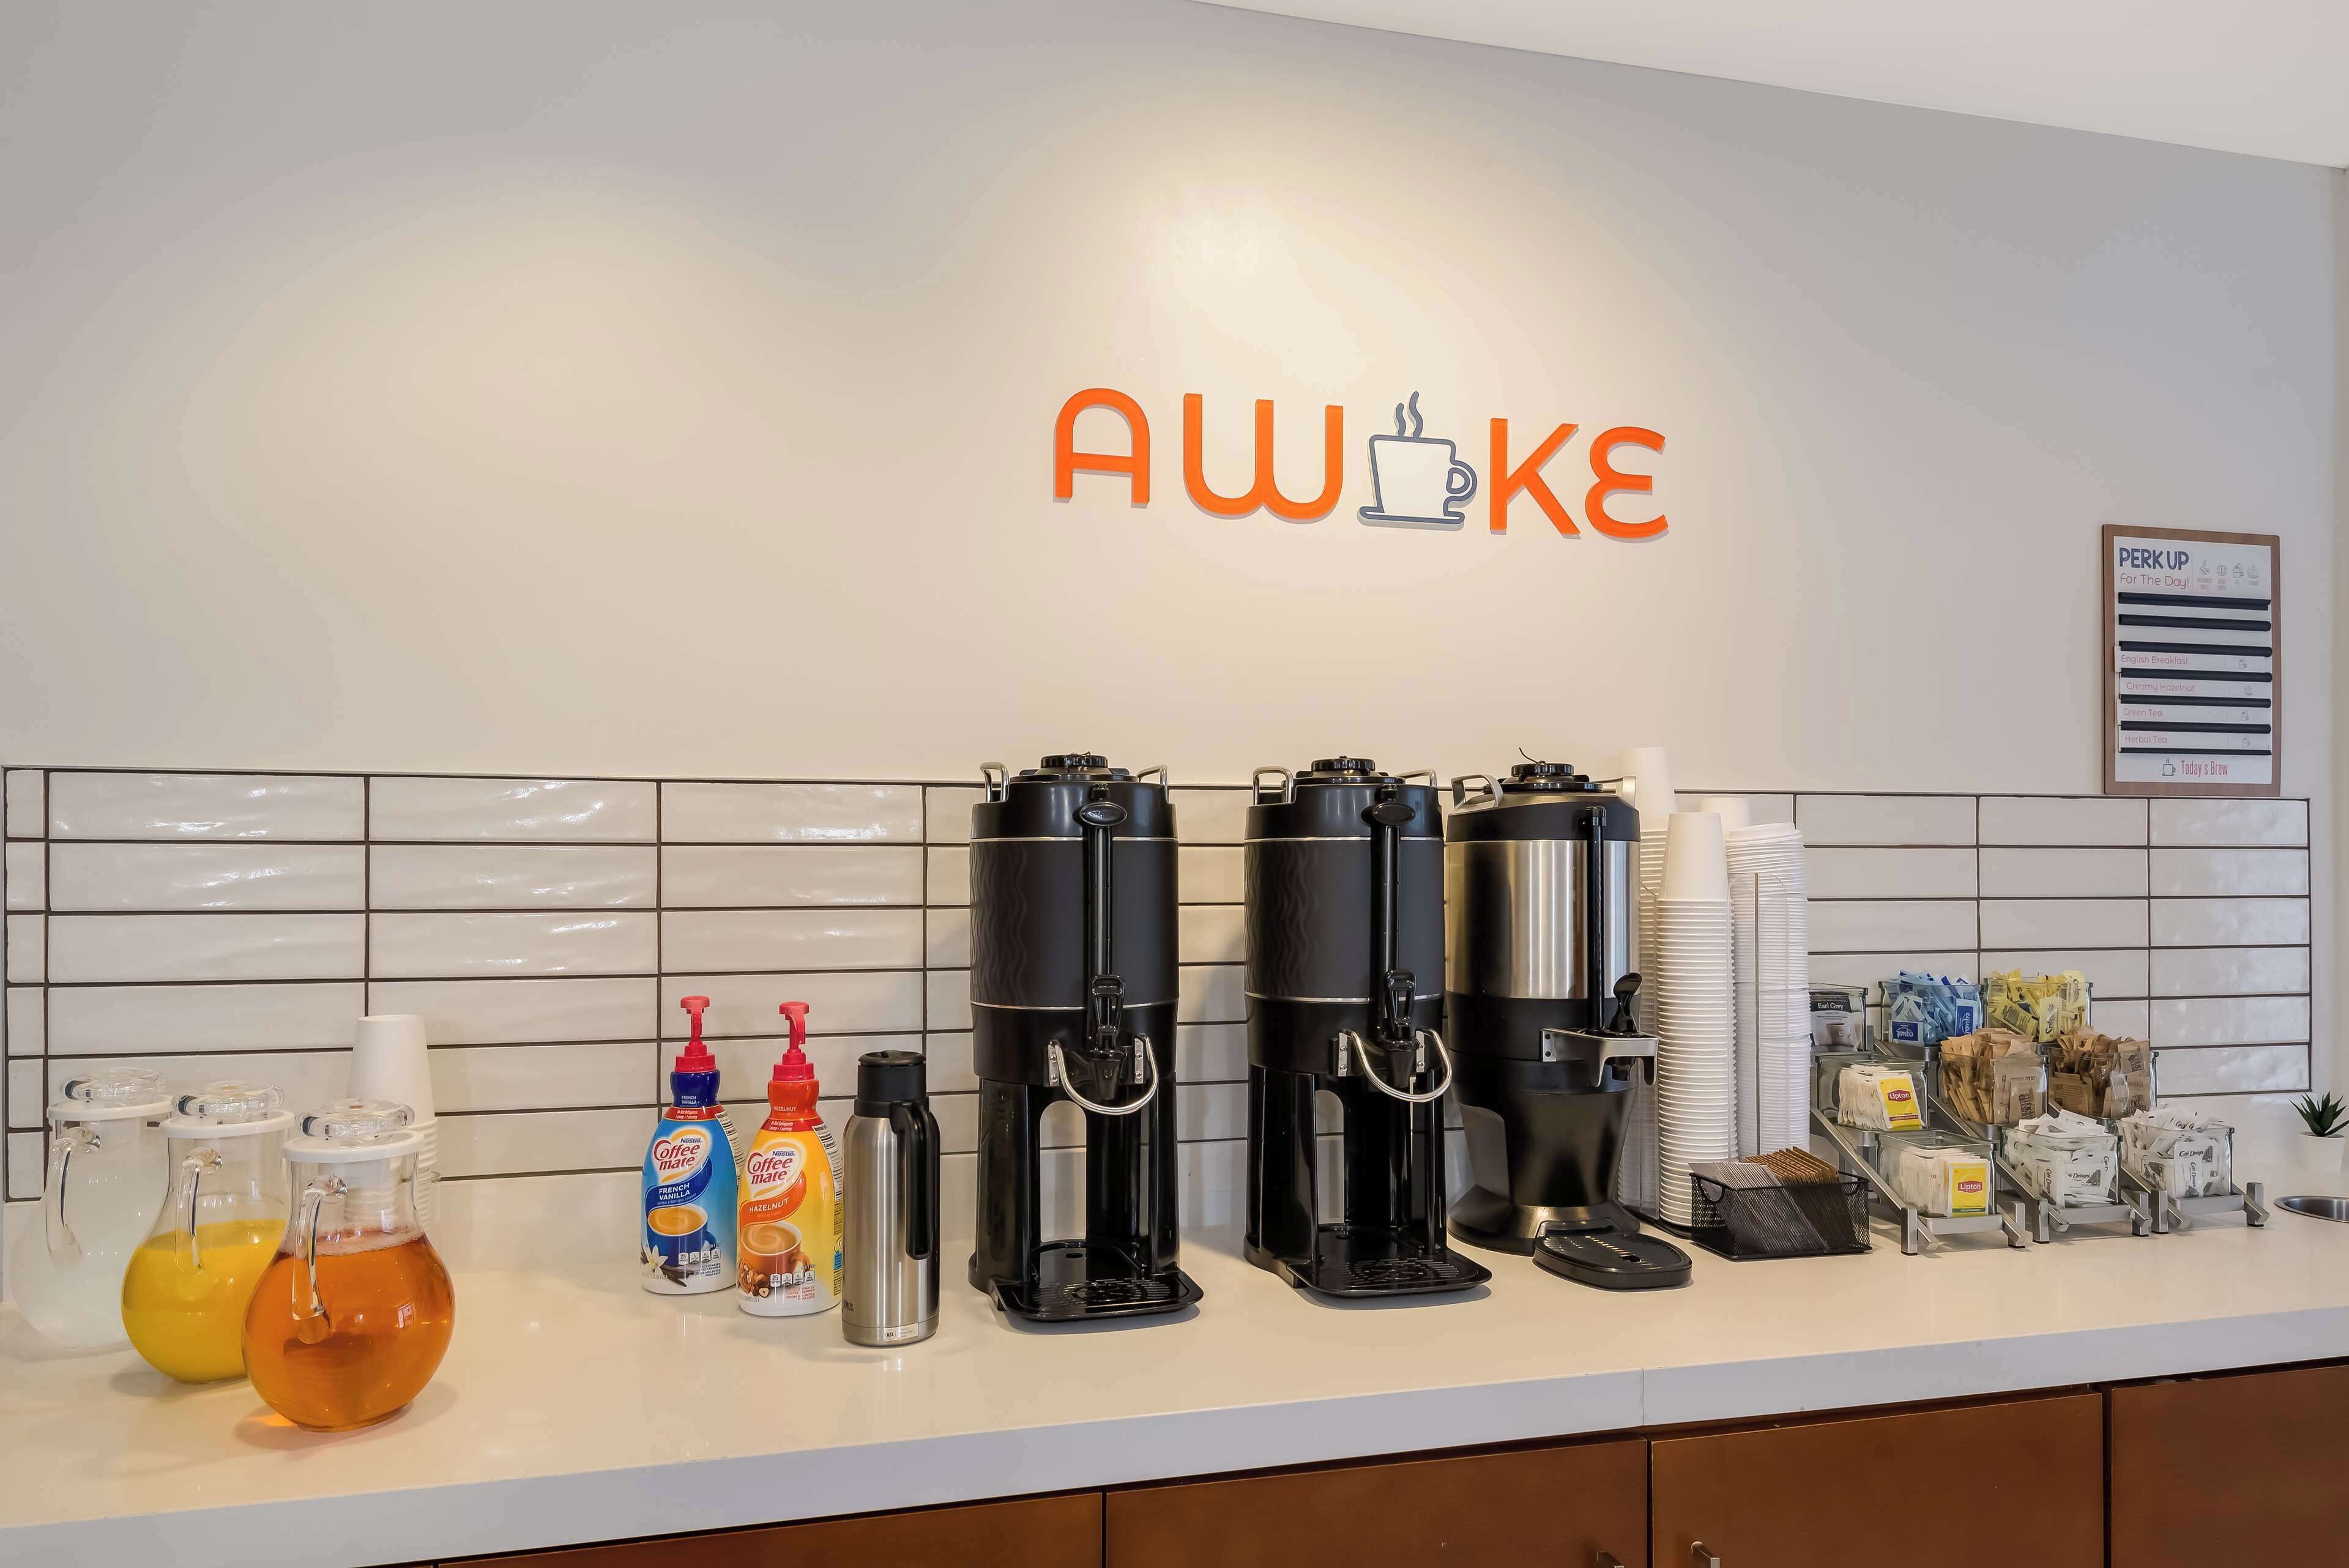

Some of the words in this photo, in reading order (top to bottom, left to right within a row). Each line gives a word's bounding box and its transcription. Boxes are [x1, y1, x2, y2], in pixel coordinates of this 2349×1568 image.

[2119, 547, 2164, 570] PERK
[2167, 551, 2189, 571] UP
[2120, 573, 2137, 584] For
[2140, 574, 2161, 585] The
[2165, 576, 2189, 590] Day!
[2121, 655, 2150, 664] English
[2151, 656, 2189, 665] Breakfast
[2126, 682, 2158, 692] Creamy
[2160, 683, 2195, 692] Hazelnut
[2123, 708, 2146, 716] Green
[2148, 708, 2162, 717] Tea
[2153, 735, 2167, 744] Tea
[2181, 760, 2208, 777] Today's
[2211, 761, 2228, 776] Brew
[1896, 1028, 1913, 1038] equal
[654, 1140, 700, 1161] Coffee
[658, 1156, 695, 1171] mate
[747, 1152, 793, 1175] Coffee
[751, 1170, 787, 1184] mate
[658, 1183, 690, 1194] FRENCH
[659, 1189, 690, 1200] VANILLA
[749, 1197, 790, 1214] HAZELNUT
